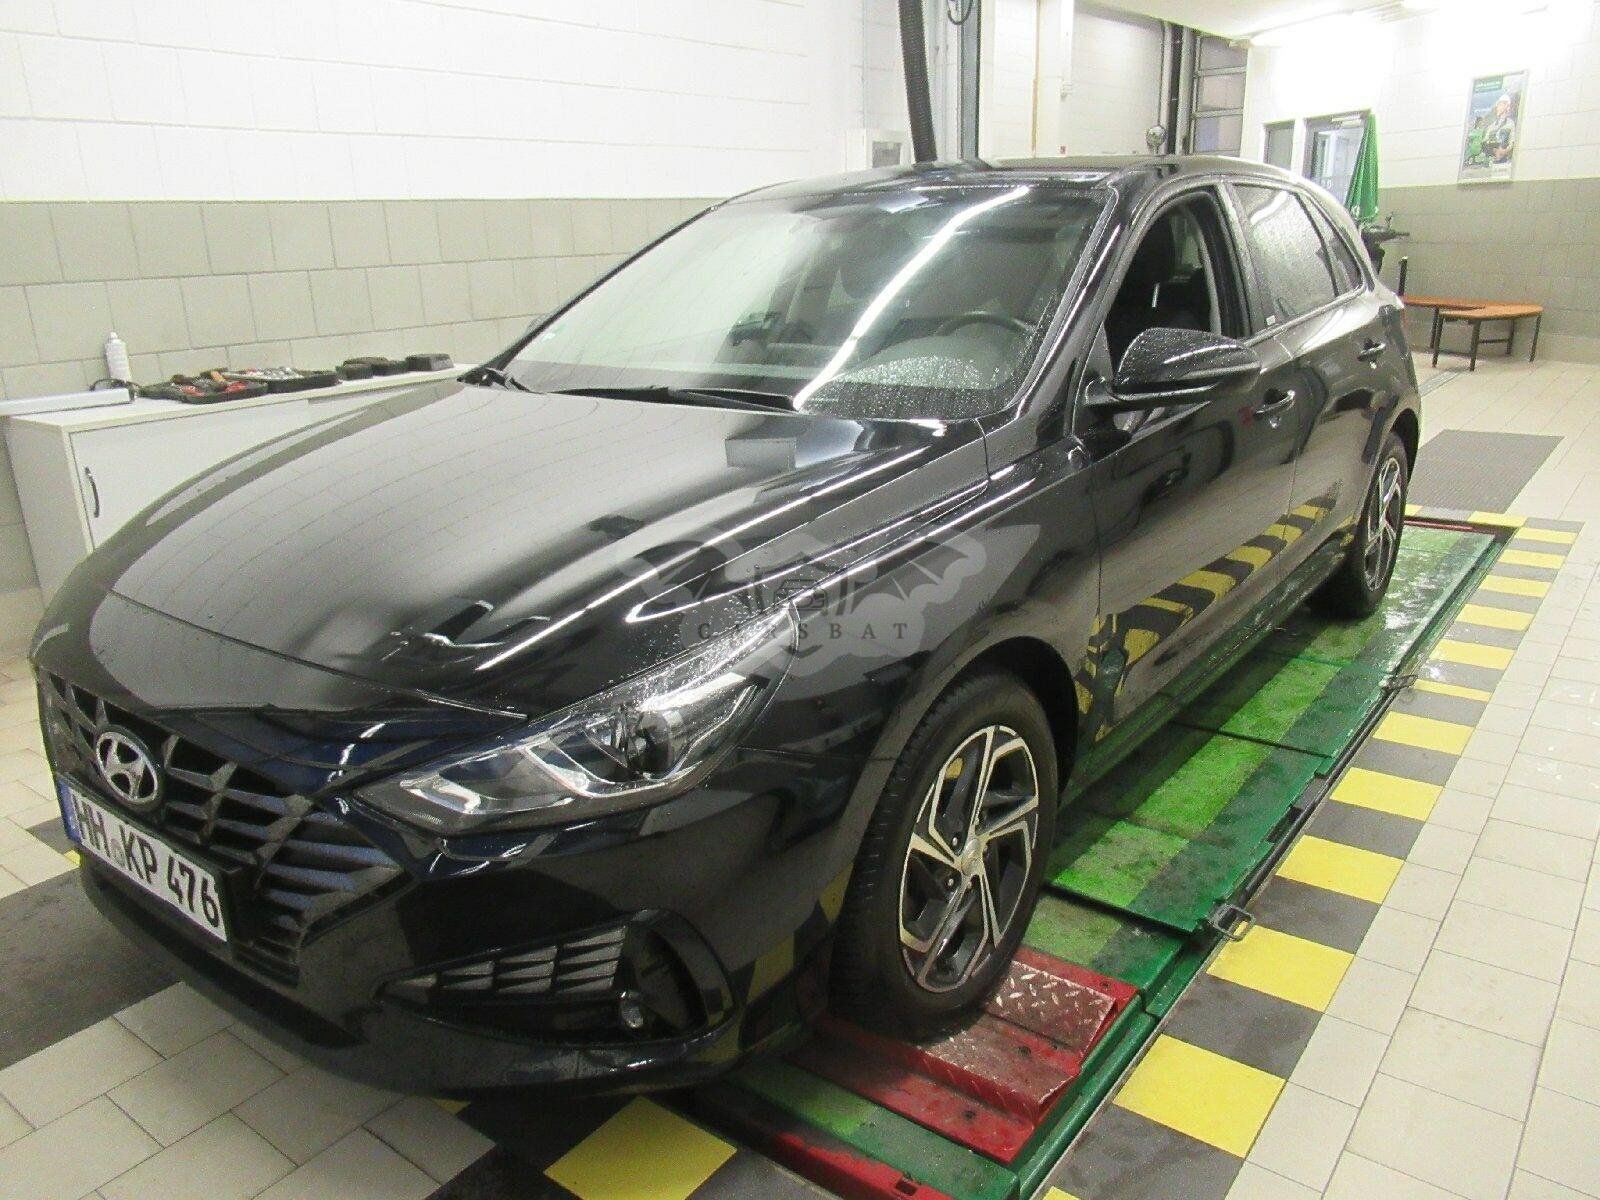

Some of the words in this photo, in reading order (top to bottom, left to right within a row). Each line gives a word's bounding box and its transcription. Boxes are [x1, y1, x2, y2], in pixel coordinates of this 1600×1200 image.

[71, 791, 111, 858] HH
[119, 824, 158, 884] KP
[167, 855, 220, 928] 476
